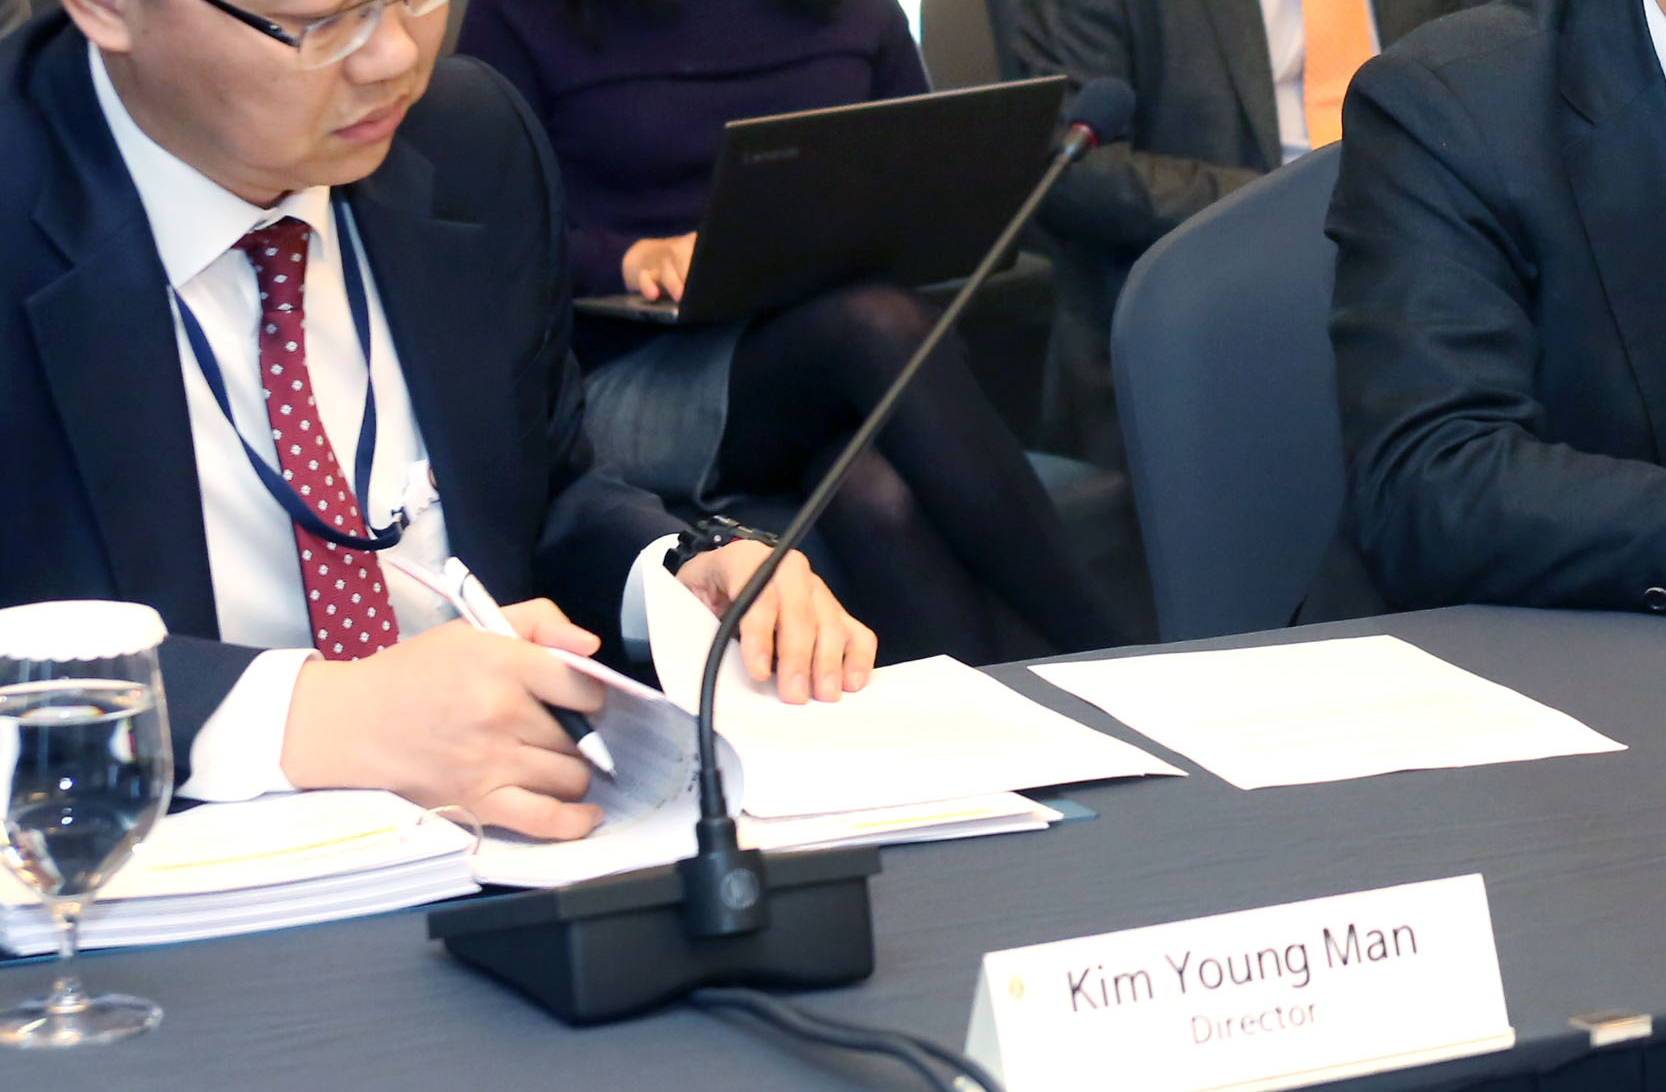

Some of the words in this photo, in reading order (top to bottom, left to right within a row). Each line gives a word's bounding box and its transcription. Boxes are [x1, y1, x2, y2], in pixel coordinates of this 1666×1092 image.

[1066, 964, 1155, 1013] Kim
[1164, 943, 1312, 995] Young
[1321, 922, 1418, 969] Man
[1189, 1003, 1317, 1045] Director
